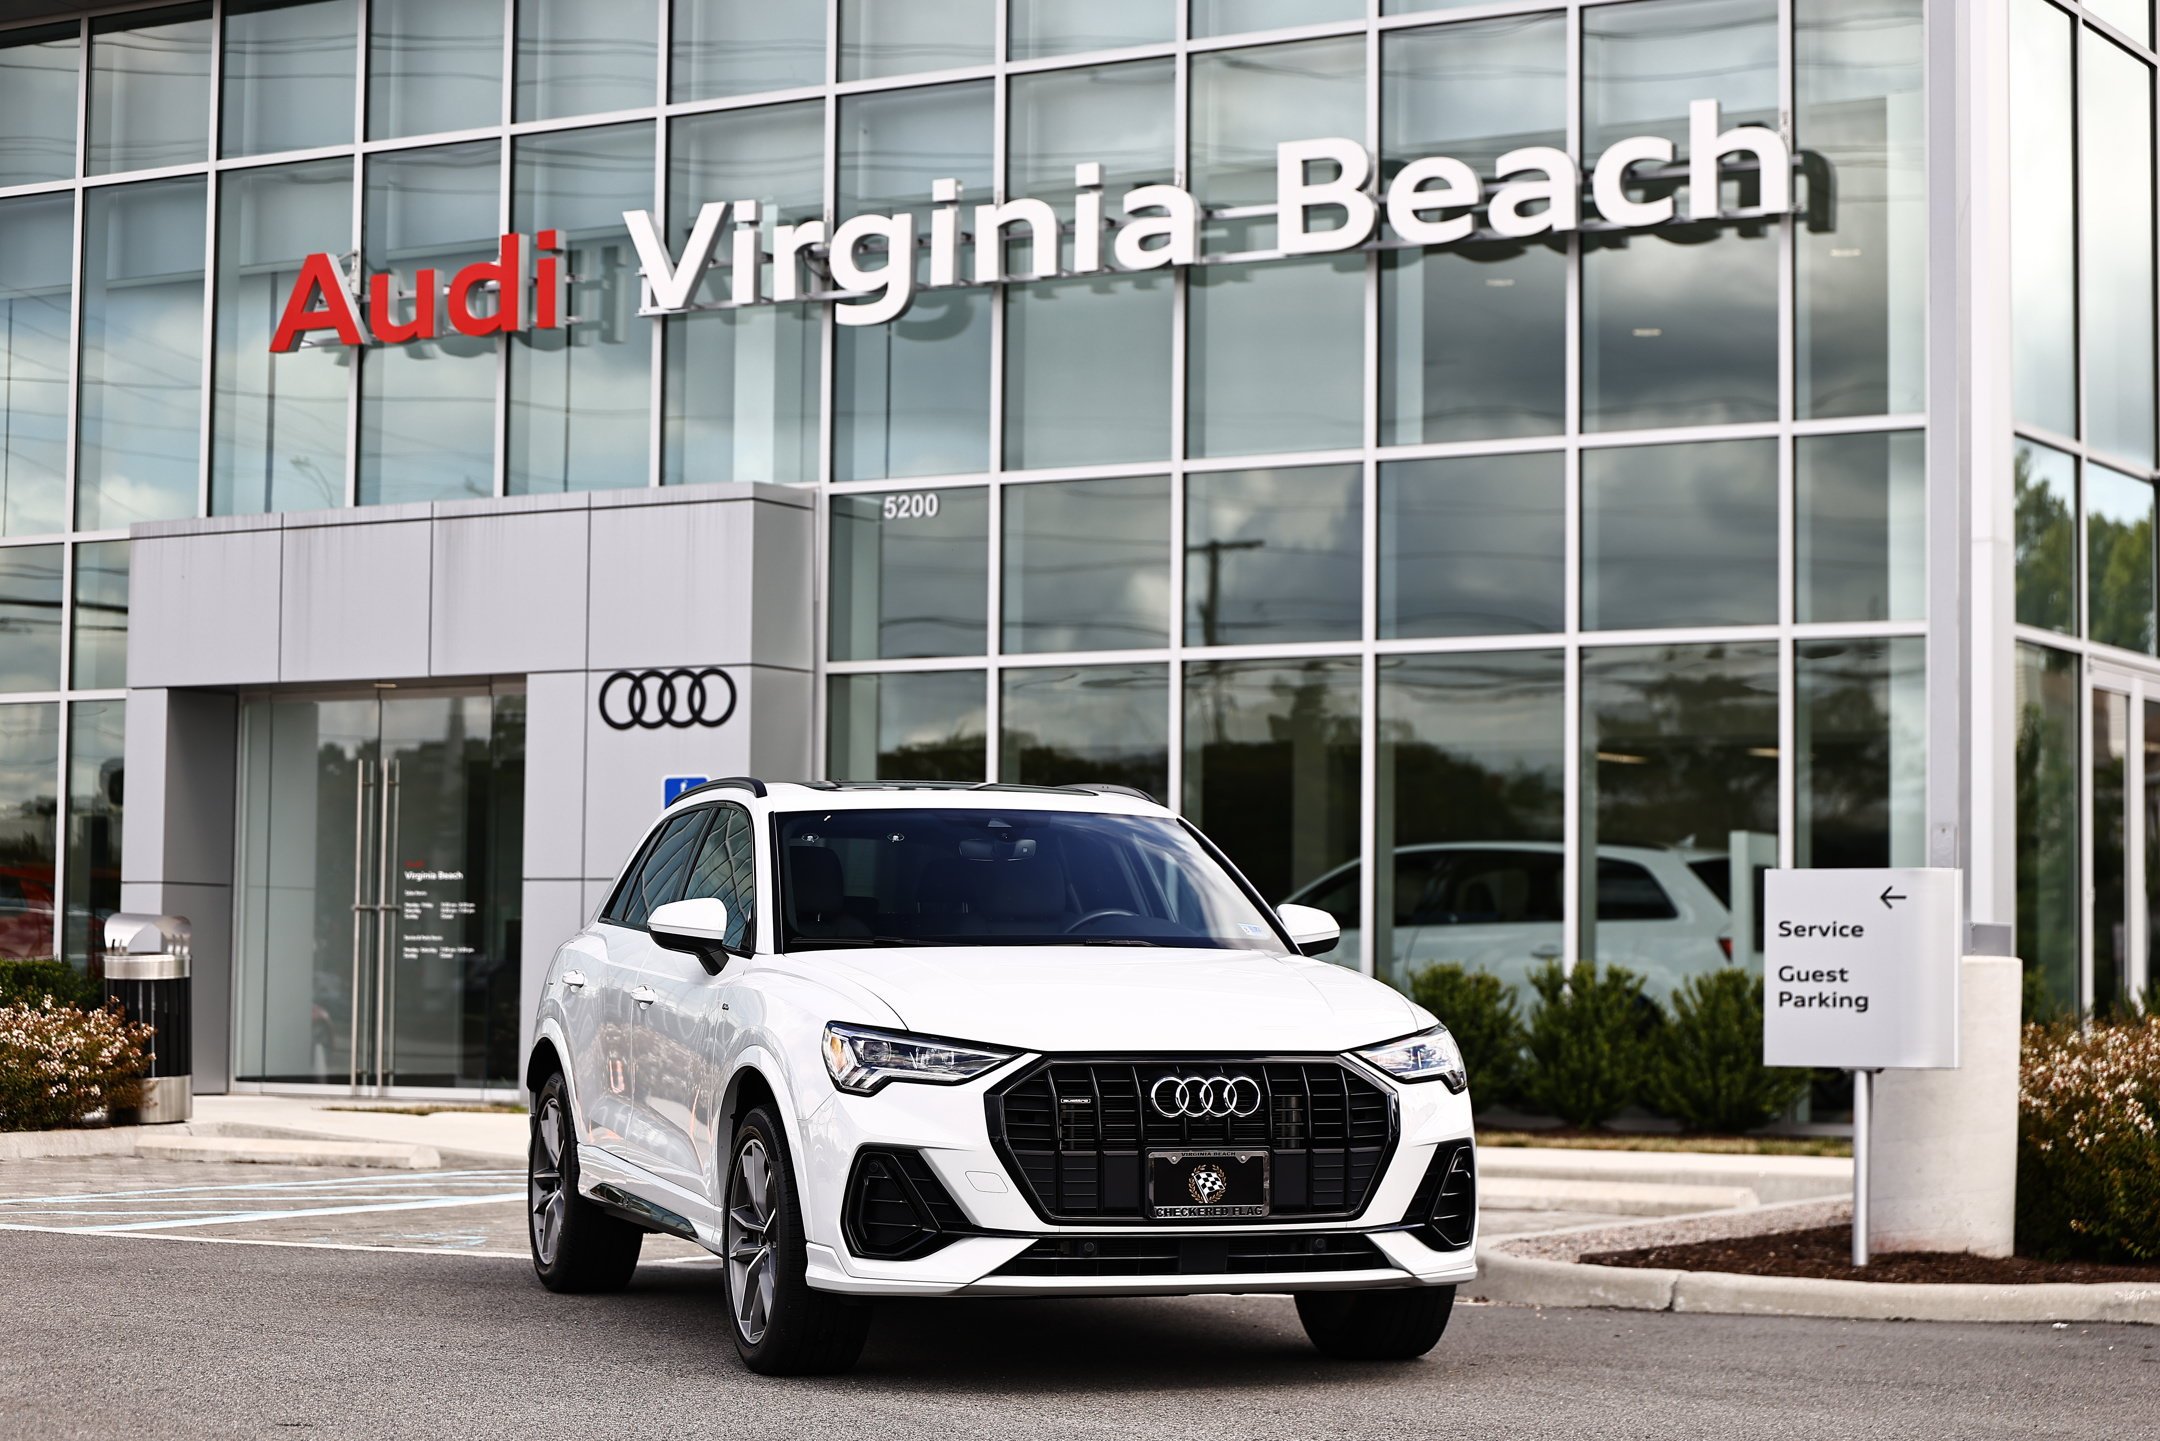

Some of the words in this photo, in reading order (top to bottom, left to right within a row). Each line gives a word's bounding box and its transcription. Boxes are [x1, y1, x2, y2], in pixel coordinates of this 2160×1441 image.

[269, 229, 566, 353] Audi
[623, 162, 1201, 326] Virginia
[1276, 98, 1793, 255] Beach
[884, 493, 939, 519] 5200
[1778, 920, 1864, 937] Service
[1778, 966, 1849, 983] Guest
[1778, 991, 1869, 1013] Parking
[1155, 1206, 1228, 1217] CHECKERED
[1232, 1206, 1263, 1216] FLAG
